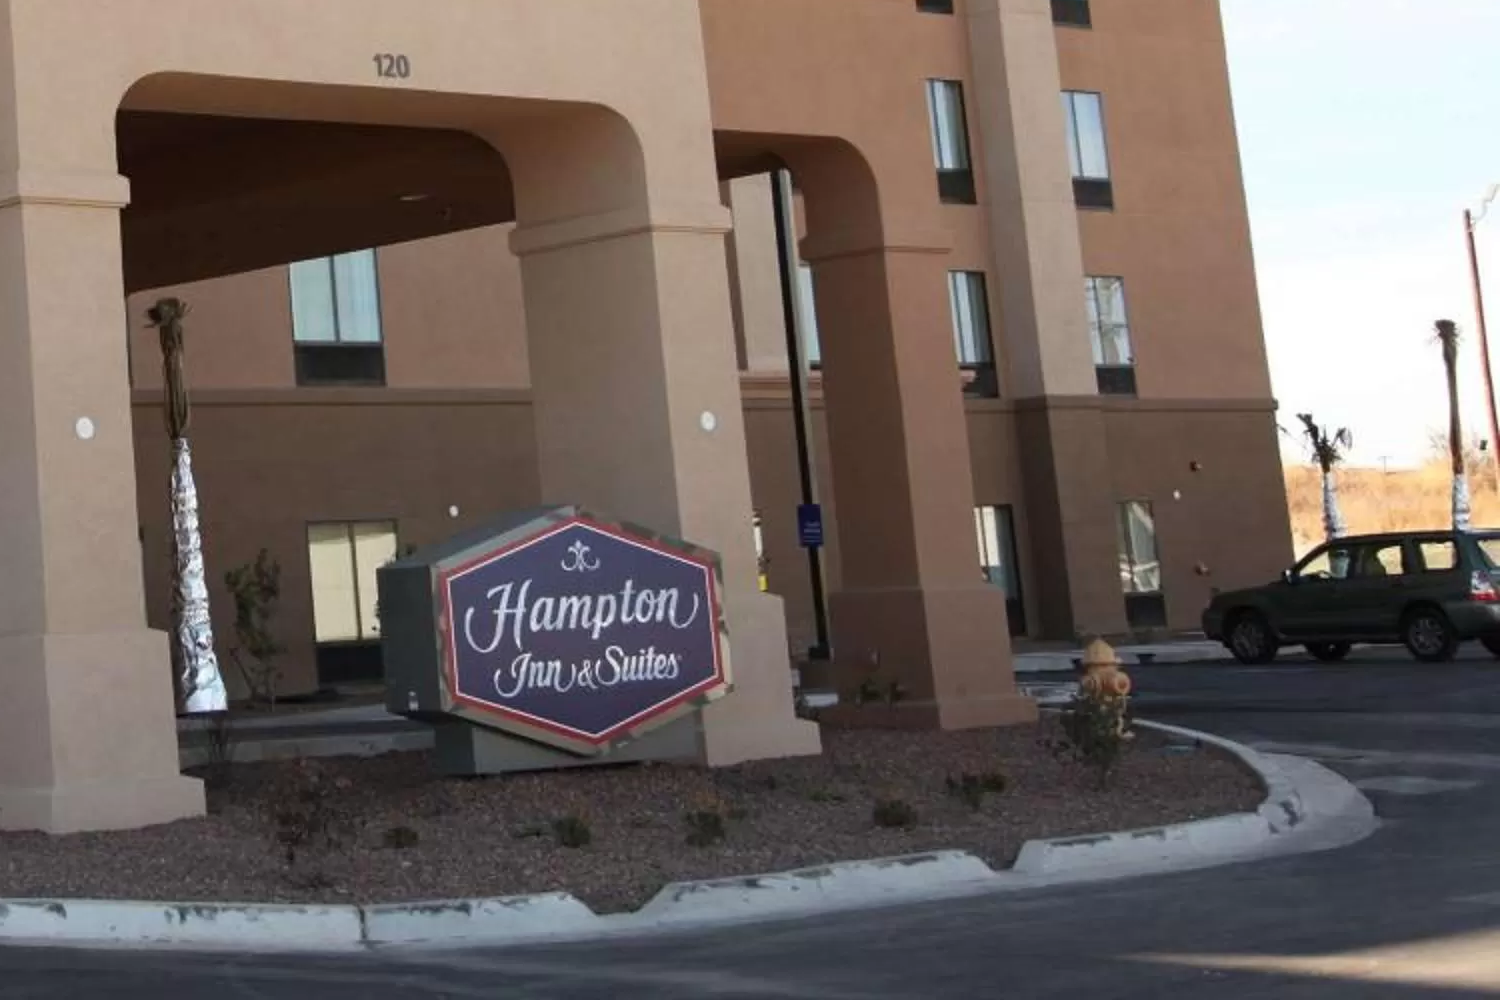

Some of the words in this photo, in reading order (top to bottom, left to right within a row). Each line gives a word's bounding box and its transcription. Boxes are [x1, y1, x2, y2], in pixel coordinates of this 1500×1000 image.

[372, 53, 411, 78] 120
[464, 579, 699, 653] Hampton
[493, 651, 577, 698] Inn
[577, 659, 599, 690] &
[595, 645, 680, 686] Suites
